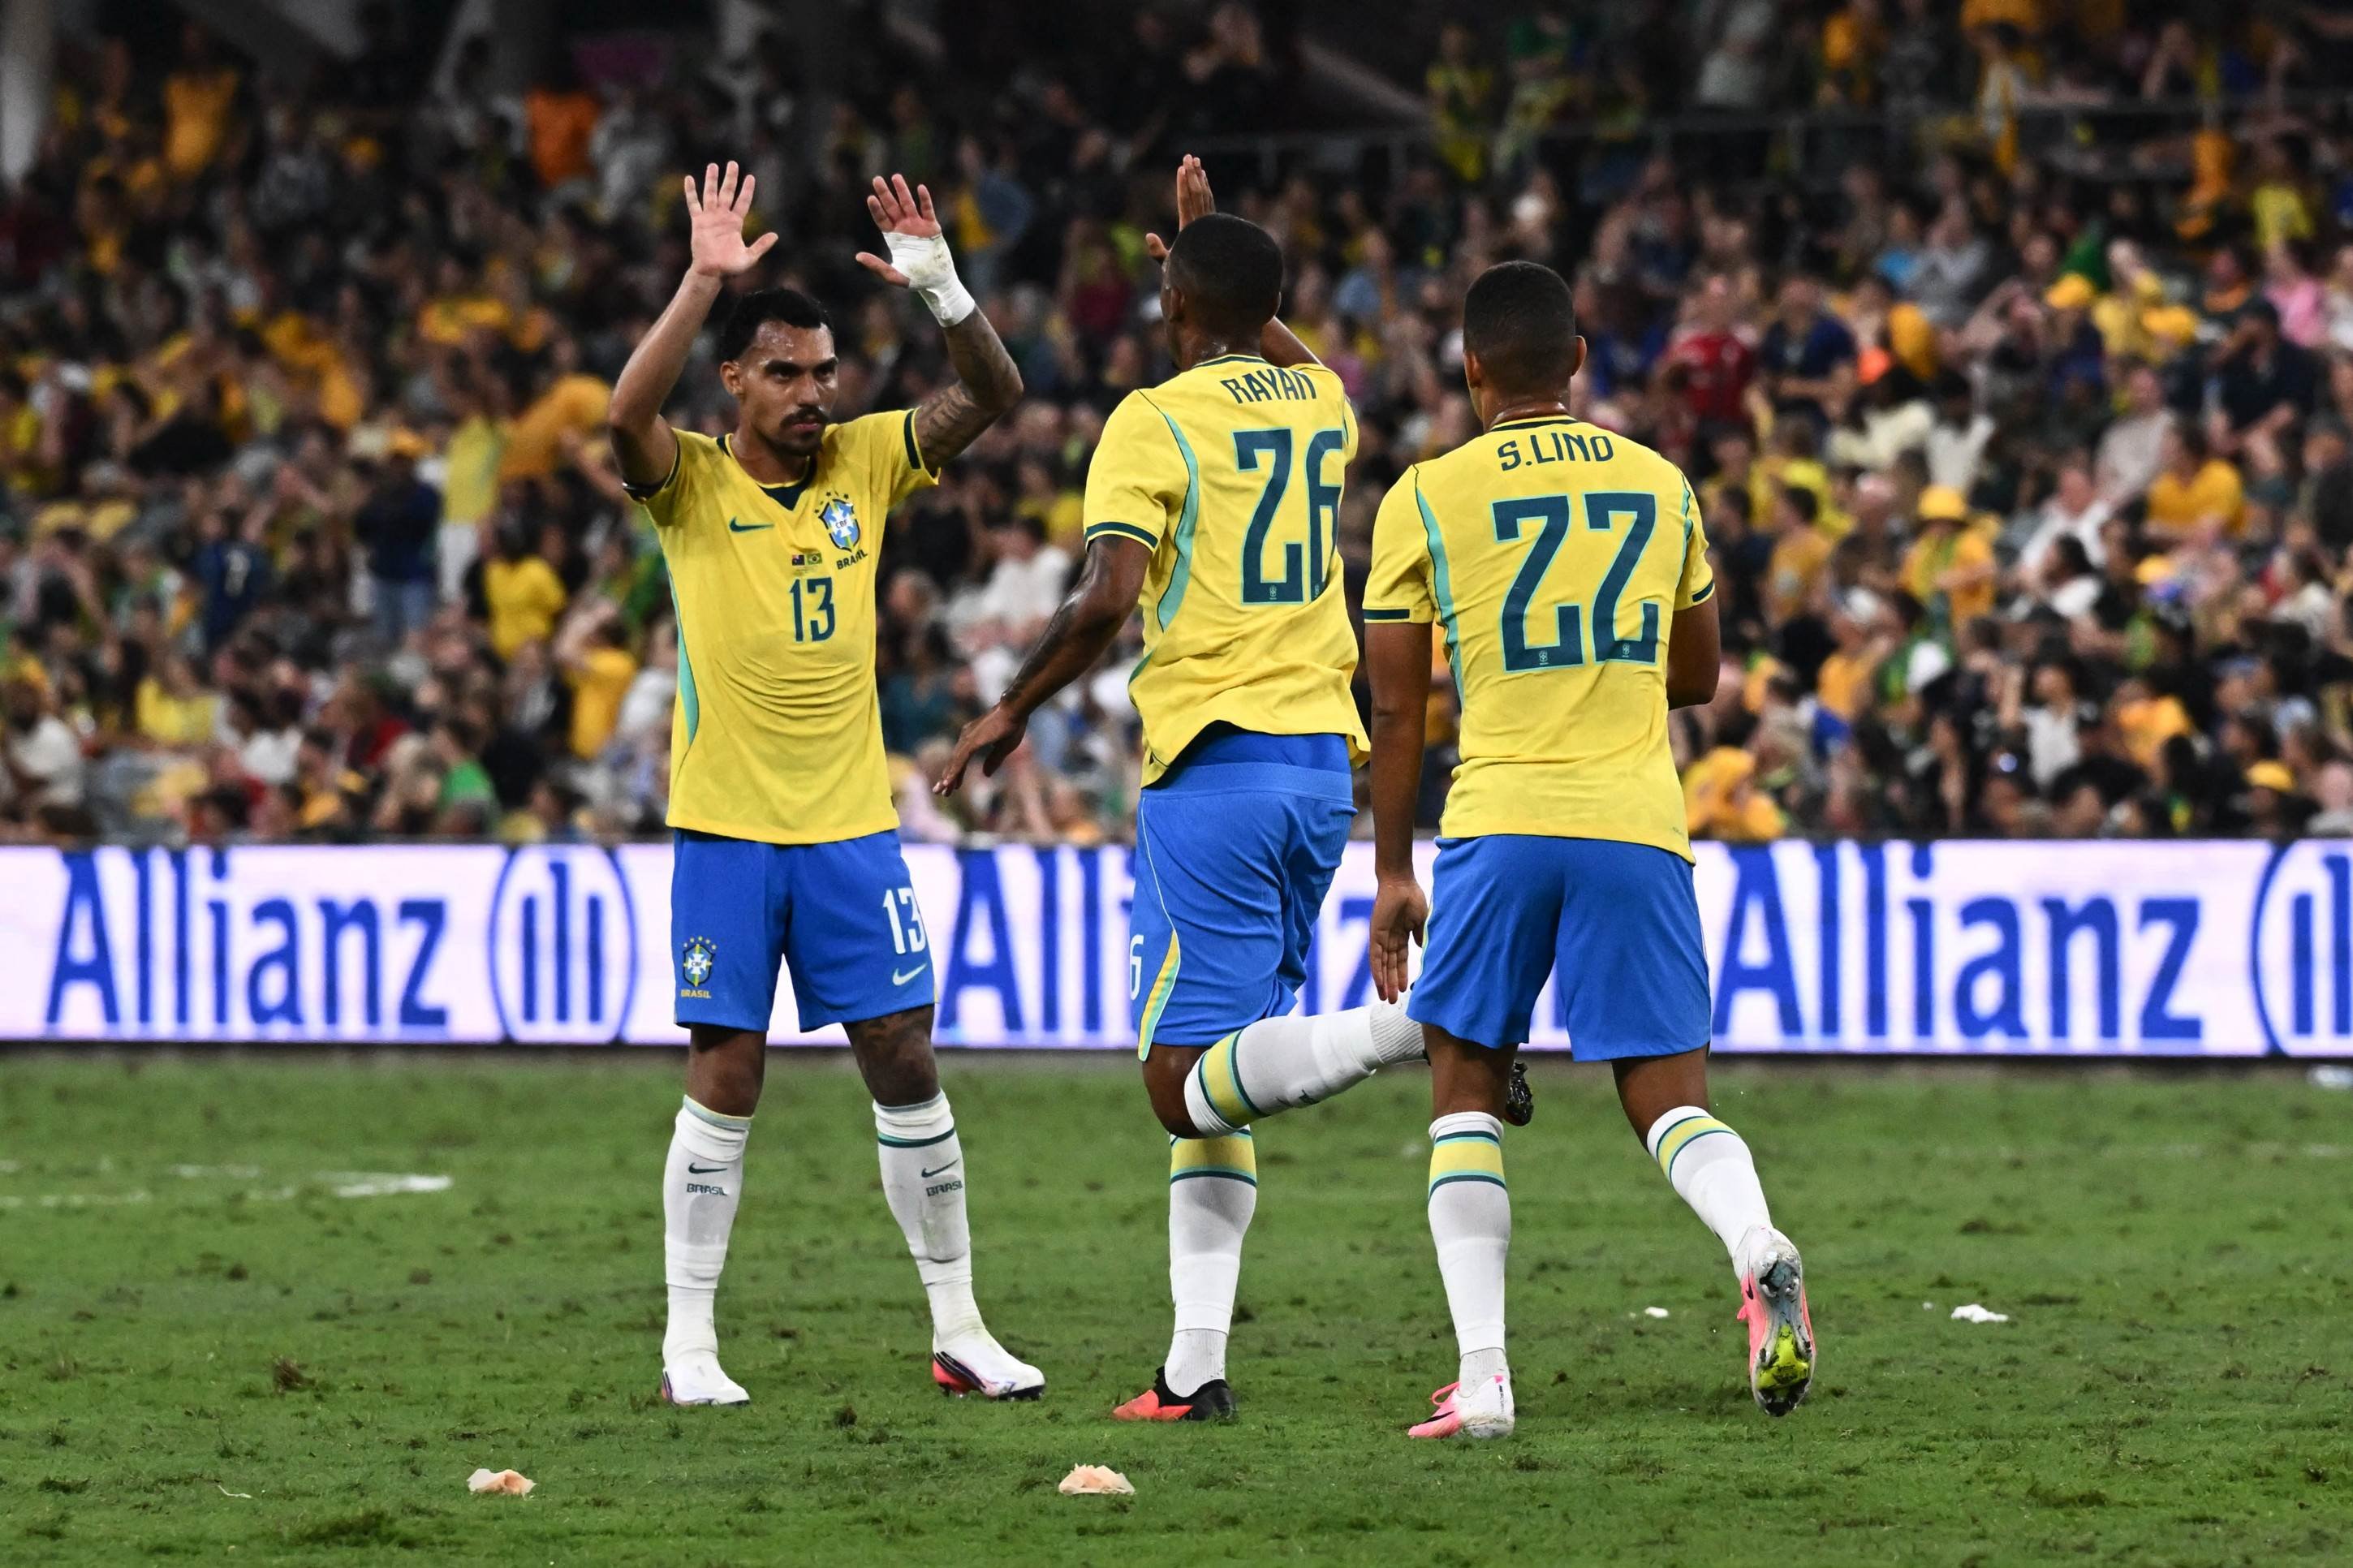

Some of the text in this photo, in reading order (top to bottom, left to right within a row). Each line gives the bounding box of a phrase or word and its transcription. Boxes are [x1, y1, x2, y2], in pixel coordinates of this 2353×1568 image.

[1220, 368, 1317, 404] RAYAN
[1498, 433, 1614, 472] S.LINO
[1232, 427, 1343, 605] 26
[789, 576, 836, 642] 13
[1491, 491, 1660, 674] 22
[45, 850, 447, 1027] Allianz
[882, 887, 926, 954] 13
[1713, 846, 2203, 1040] Allianz
[680, 989, 712, 998] BRASIL
[687, 1182, 727, 1196] BRASIL
